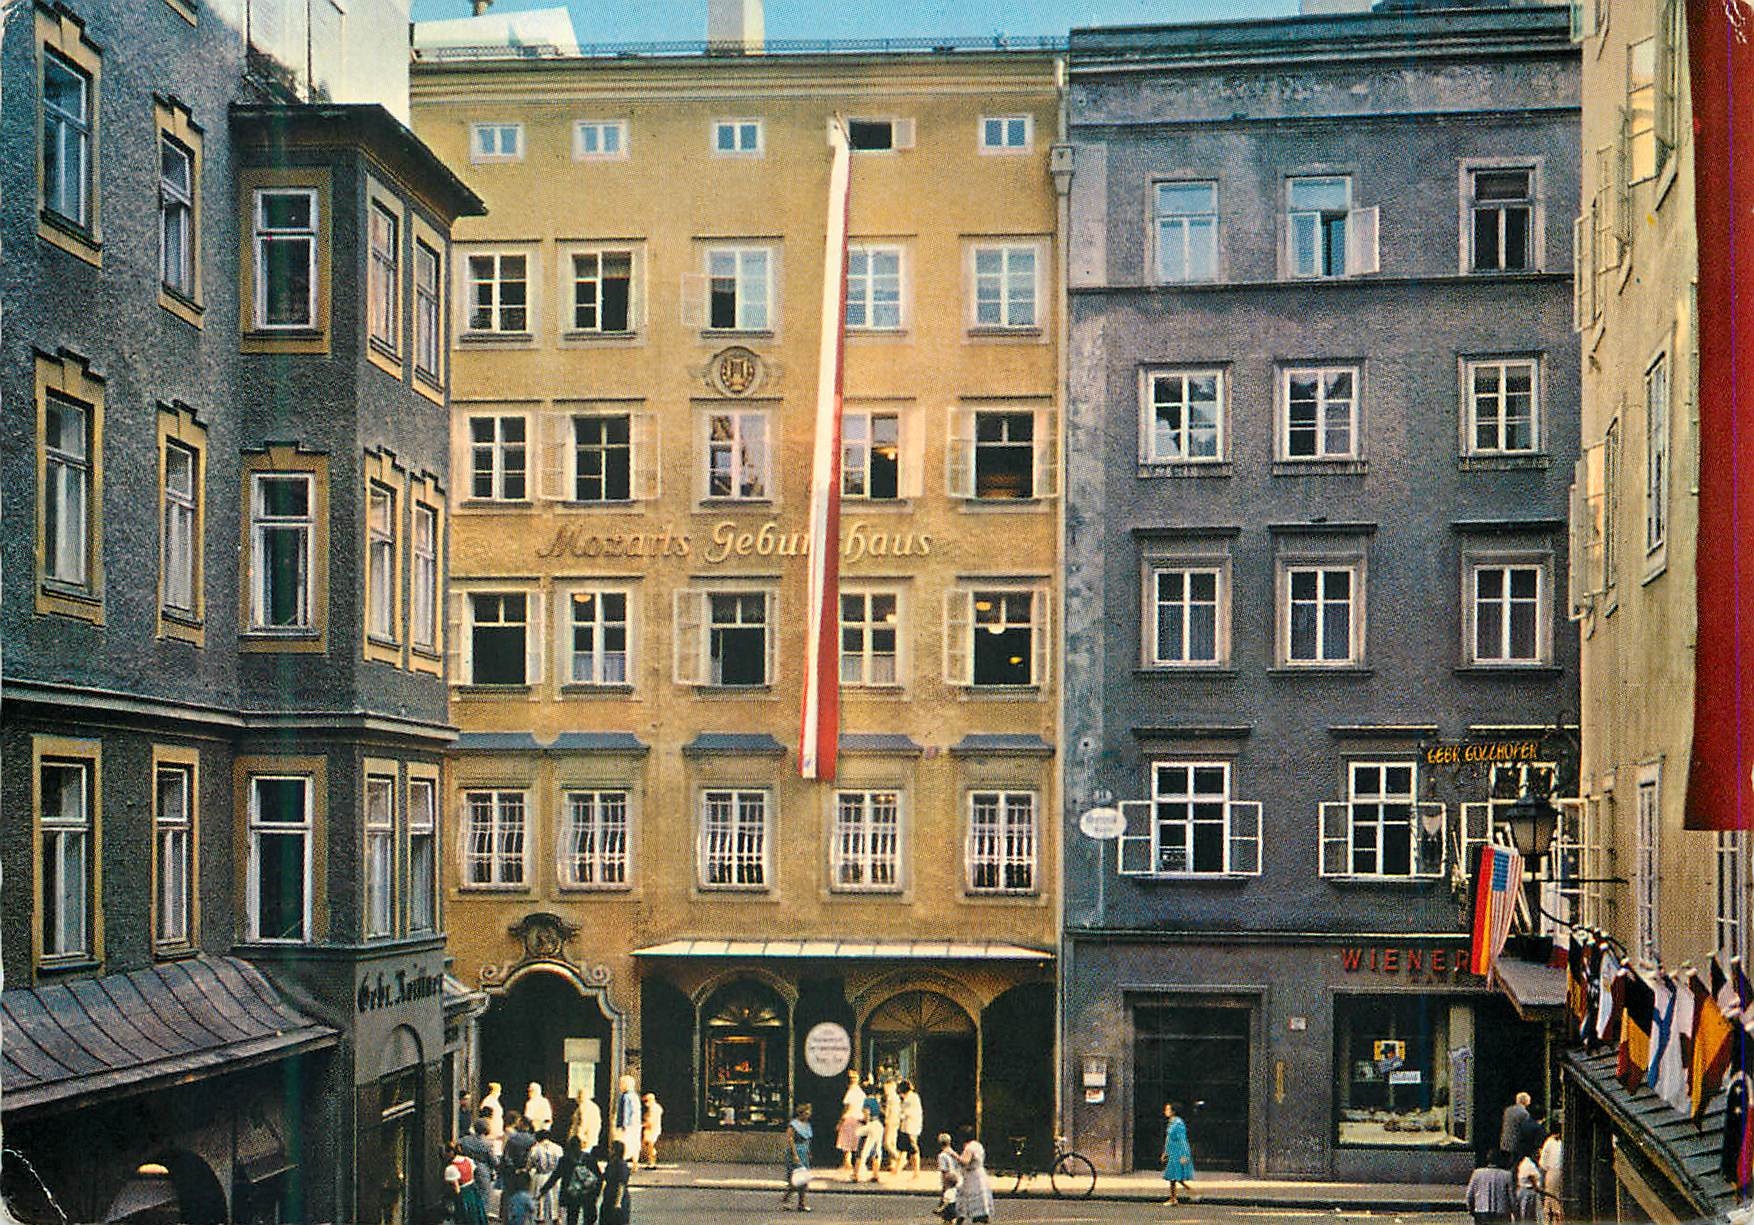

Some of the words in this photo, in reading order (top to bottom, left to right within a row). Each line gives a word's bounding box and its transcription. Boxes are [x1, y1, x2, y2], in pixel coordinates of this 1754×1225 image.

[535, 521, 690, 558] Mozarts
[705, 520, 932, 564] Geburhaus
[1341, 947, 1470, 972] WIENER
